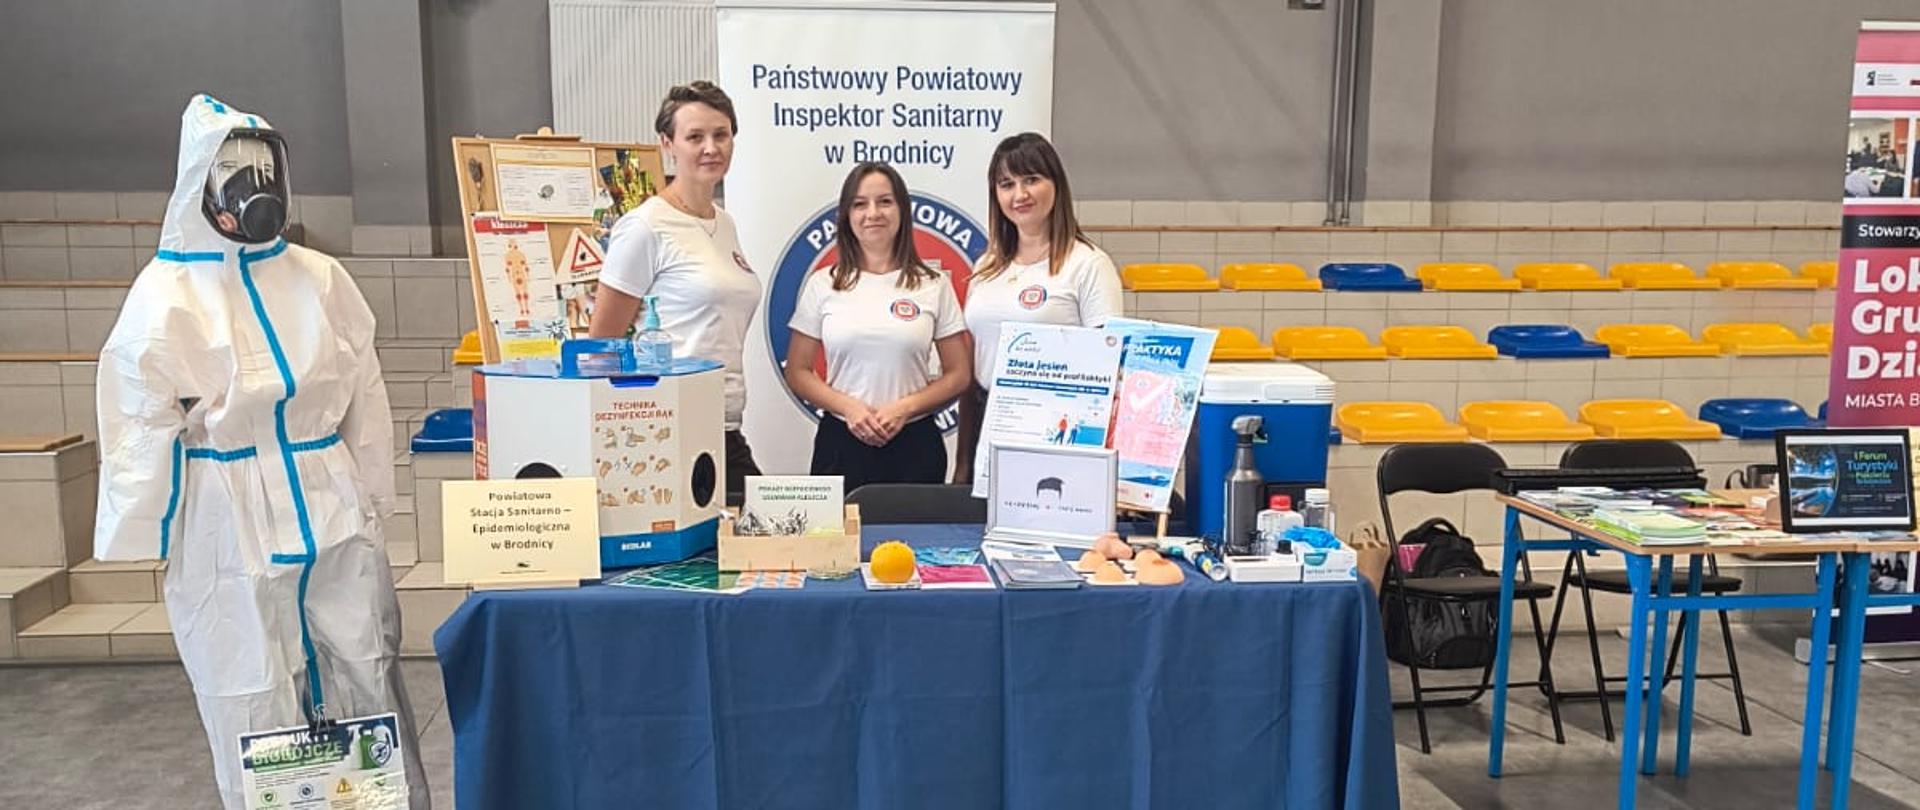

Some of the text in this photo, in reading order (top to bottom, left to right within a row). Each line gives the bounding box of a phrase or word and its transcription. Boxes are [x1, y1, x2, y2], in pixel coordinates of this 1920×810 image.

[753, 64, 1022, 96] Państwowy Powiatowy
[774, 102, 1003, 132] Inspektor Sanitarny
[824, 140, 954, 169] w Brodnicy
[1847, 340, 1920, 379] Dzi
[1845, 393, 1904, 408] MIASTA
[1846, 460, 1899, 472] Turystyki
[489, 492, 552, 501] Powiatowa
[470, 507, 505, 518] Stacja
[507, 506, 561, 517] Sanitarno
[473, 522, 571, 535] Epidemiologiczna
[491, 540, 554, 550] w Brodnicy
